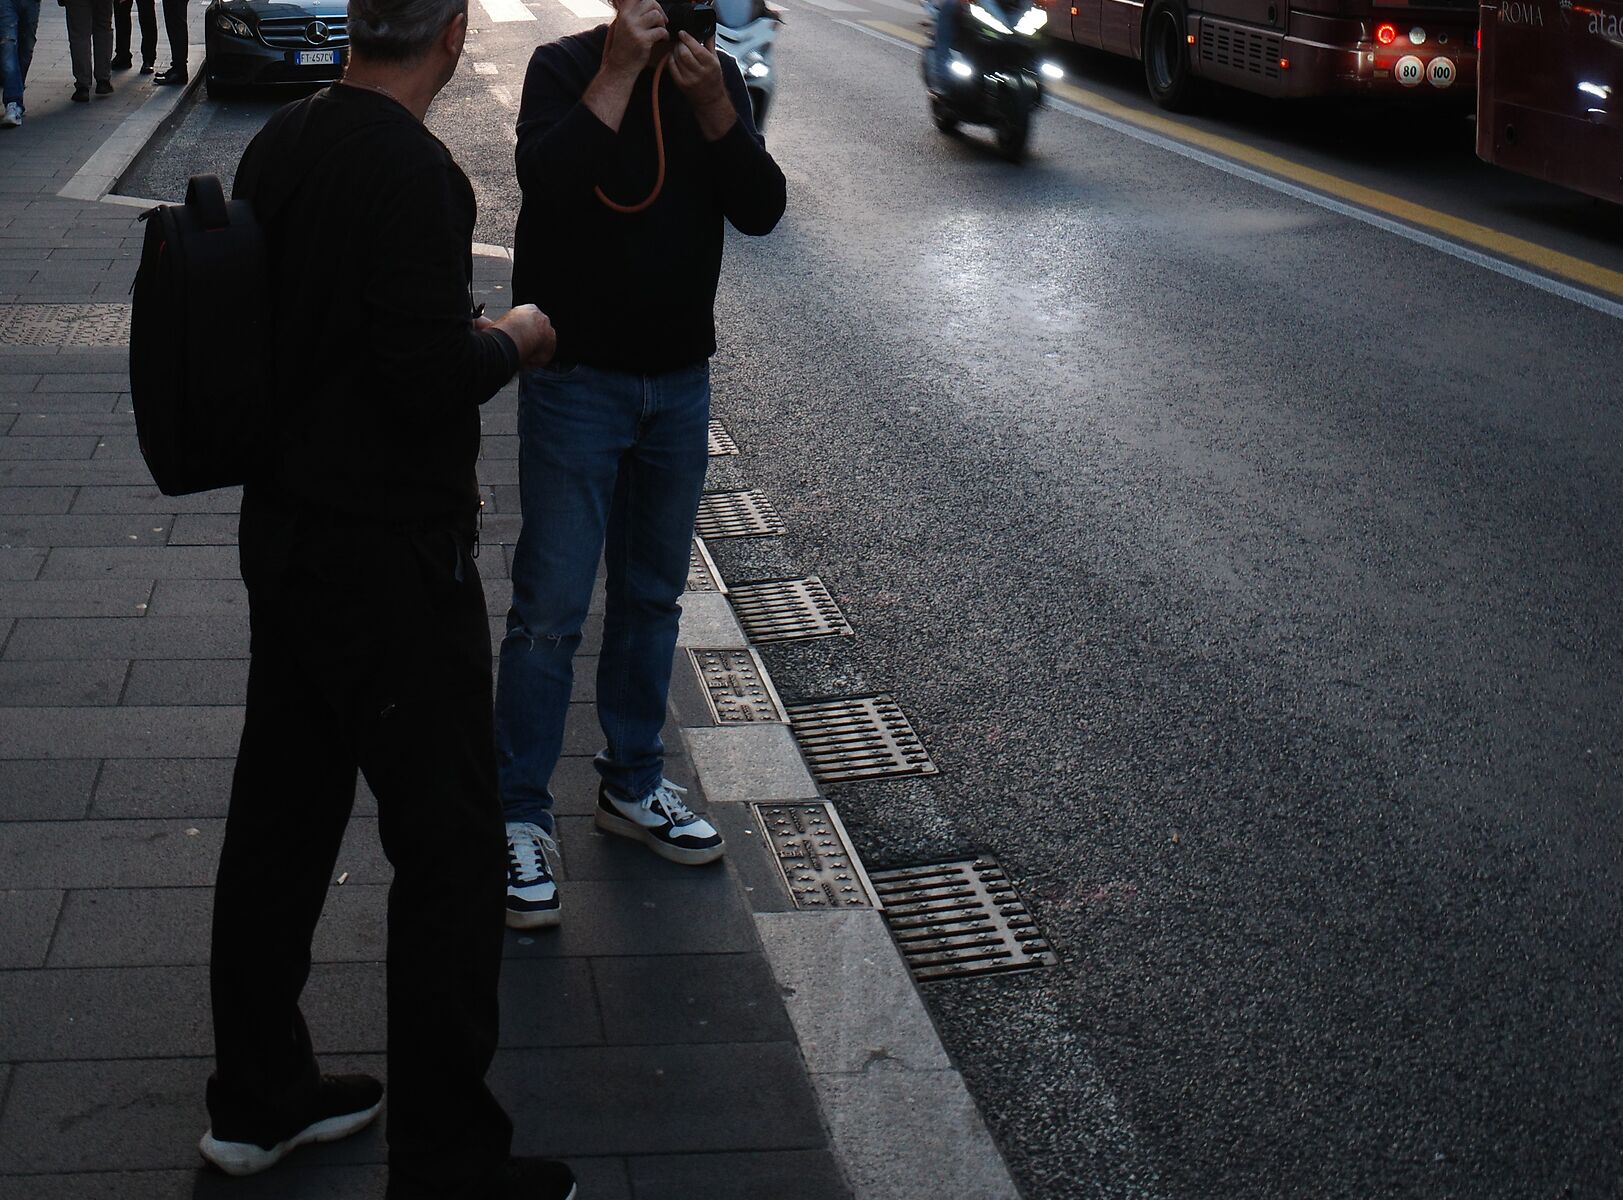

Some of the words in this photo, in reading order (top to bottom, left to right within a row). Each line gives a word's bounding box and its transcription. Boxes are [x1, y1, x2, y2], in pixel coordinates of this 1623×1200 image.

[1502, 0, 1544, 27] ROMA
[1403, 65, 1417, 78] 80
[1433, 66, 1451, 79] 100
